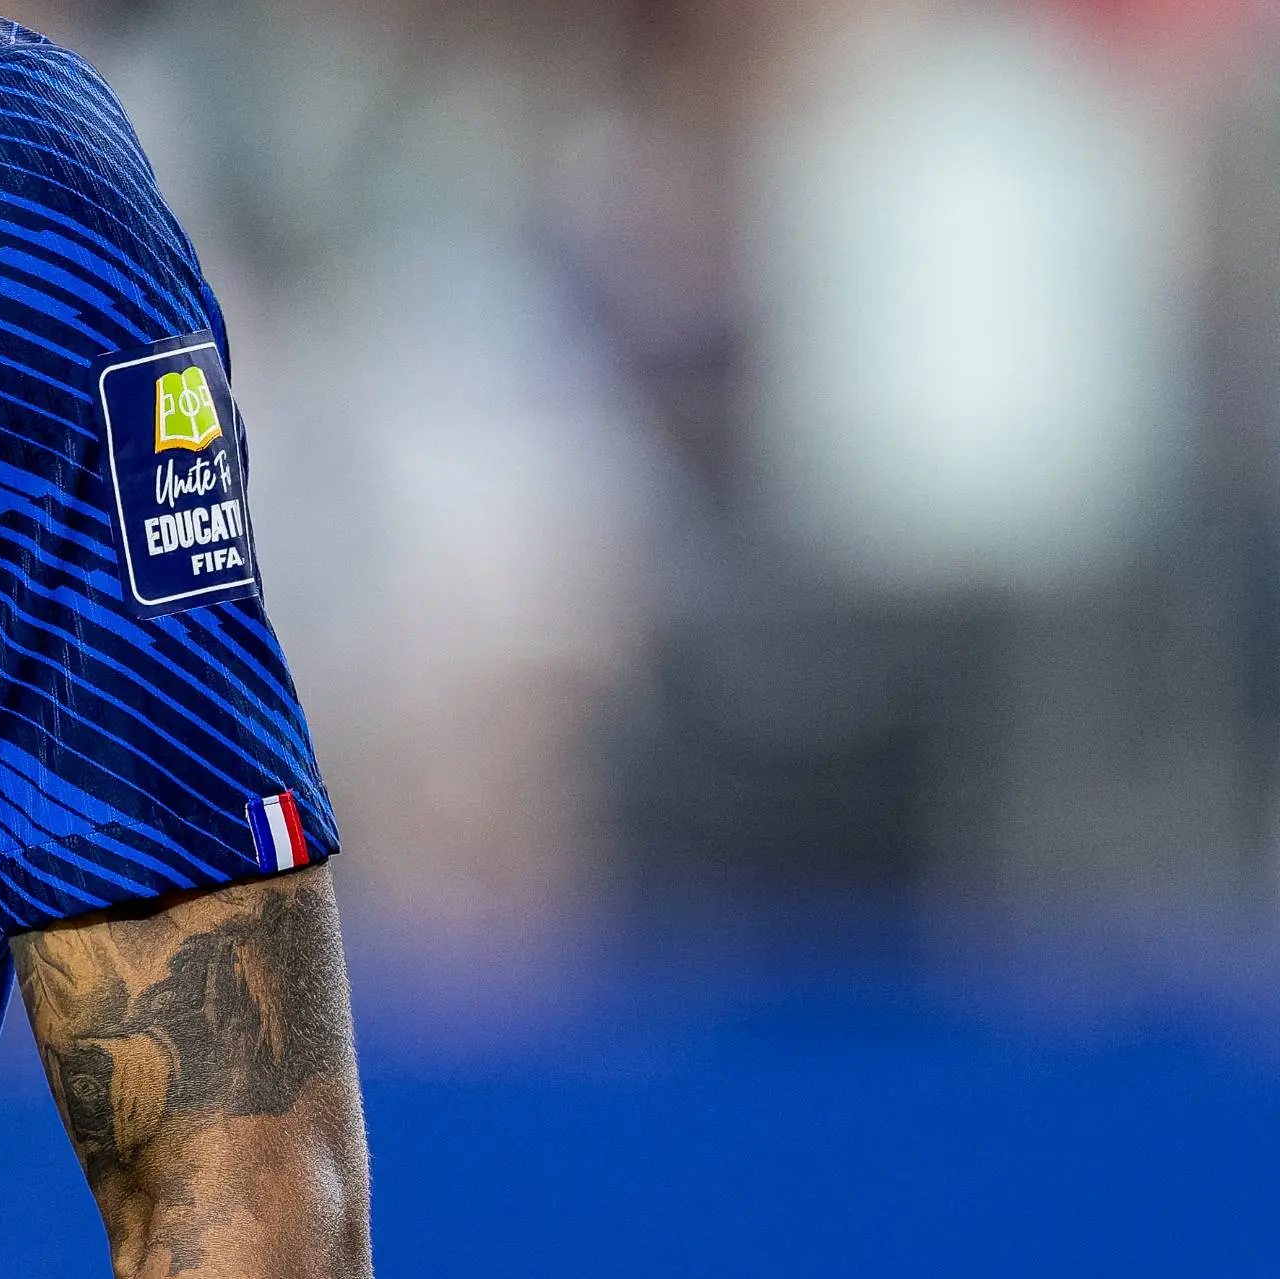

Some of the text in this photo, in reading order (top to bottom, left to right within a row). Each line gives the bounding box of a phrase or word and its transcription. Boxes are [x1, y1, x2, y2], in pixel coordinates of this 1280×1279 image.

[155, 457, 217, 508] Unite
[144, 499, 244, 556] EDUCATI
[191, 546, 243, 575] FIFA
